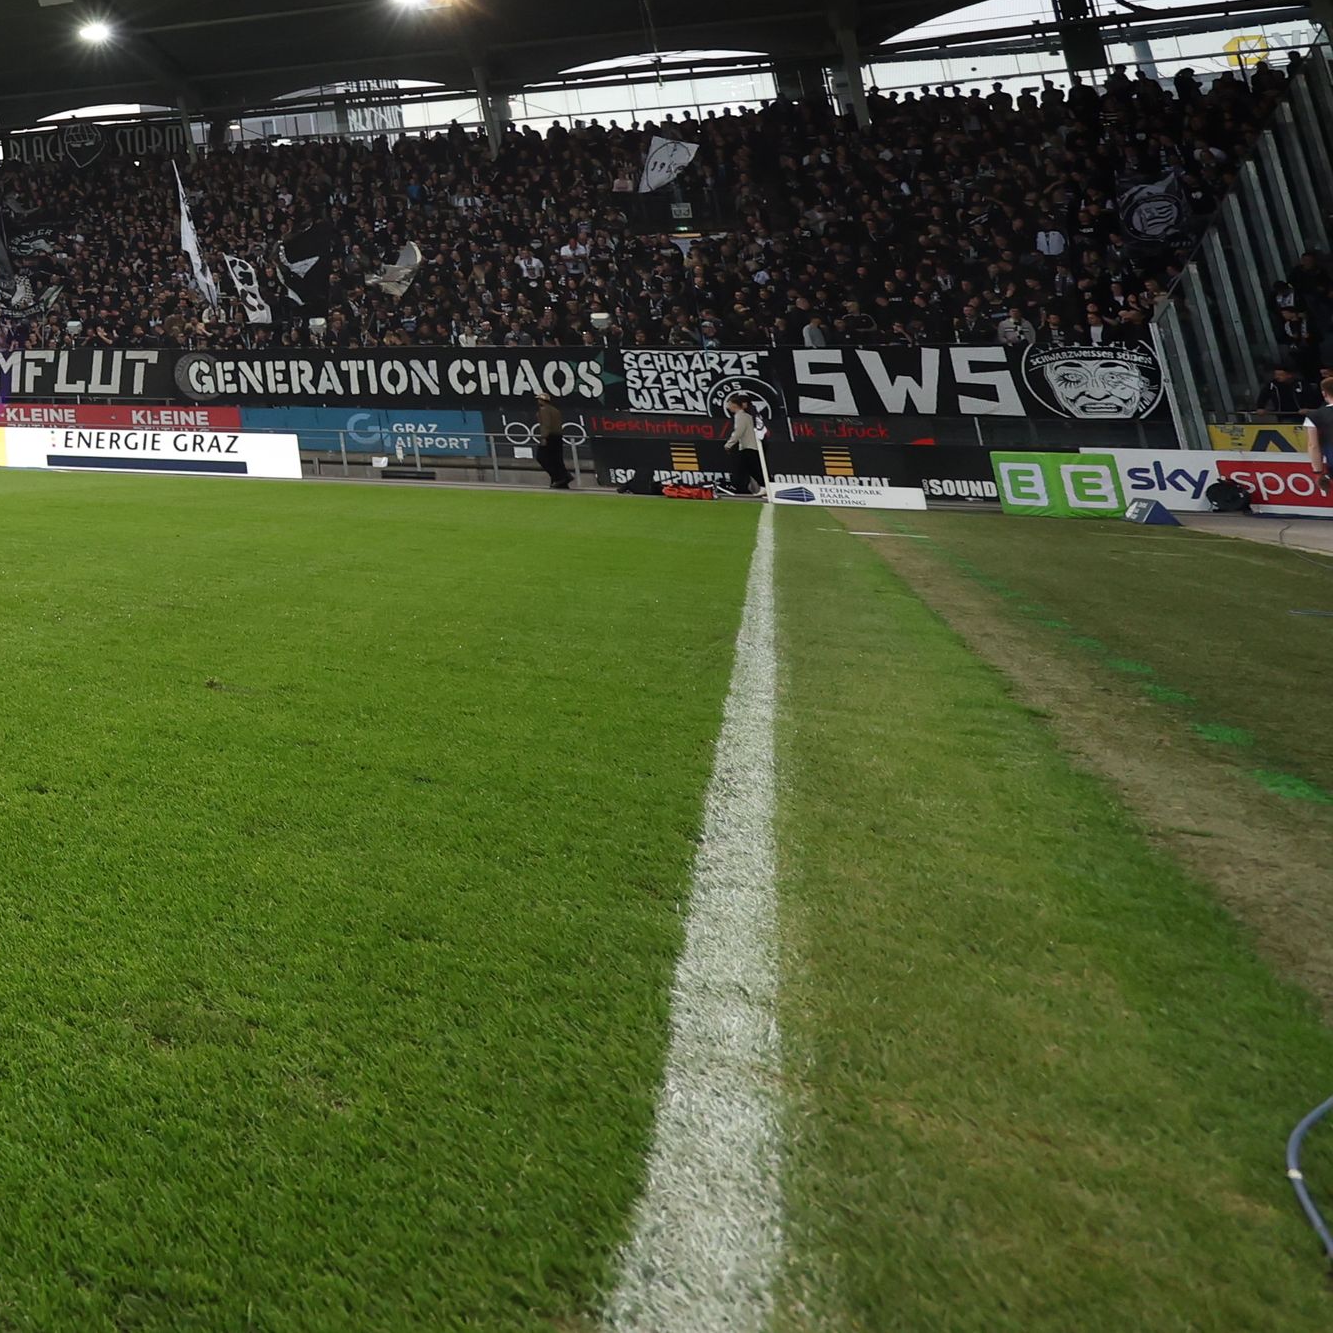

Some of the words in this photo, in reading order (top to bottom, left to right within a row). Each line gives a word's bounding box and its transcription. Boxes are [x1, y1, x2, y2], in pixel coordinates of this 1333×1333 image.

[622, 350, 761, 376] SCHWARZE
[187, 359, 440, 396] GENERATION
[447, 358, 604, 399] CHAOS
[626, 369, 712, 392] SZENE
[792, 348, 1026, 416] SWS
[628, 389, 708, 412] WIEN
[711, 381, 742, 406] 2005
[6, 407, 77, 424] KLEINE
[131, 409, 210, 427] KLEINE
[392, 423, 438, 434] GRAZ
[64, 430, 162, 452] ENERGIE
[173, 433, 239, 454] GRAZ
[395, 436, 471, 450] AIRPORT
[818, 487, 883, 496] TECHNOPARK
[1127, 460, 1210, 500] sky
[819, 492, 850, 500] RAABA
[820, 498, 867, 507] HOLDING
